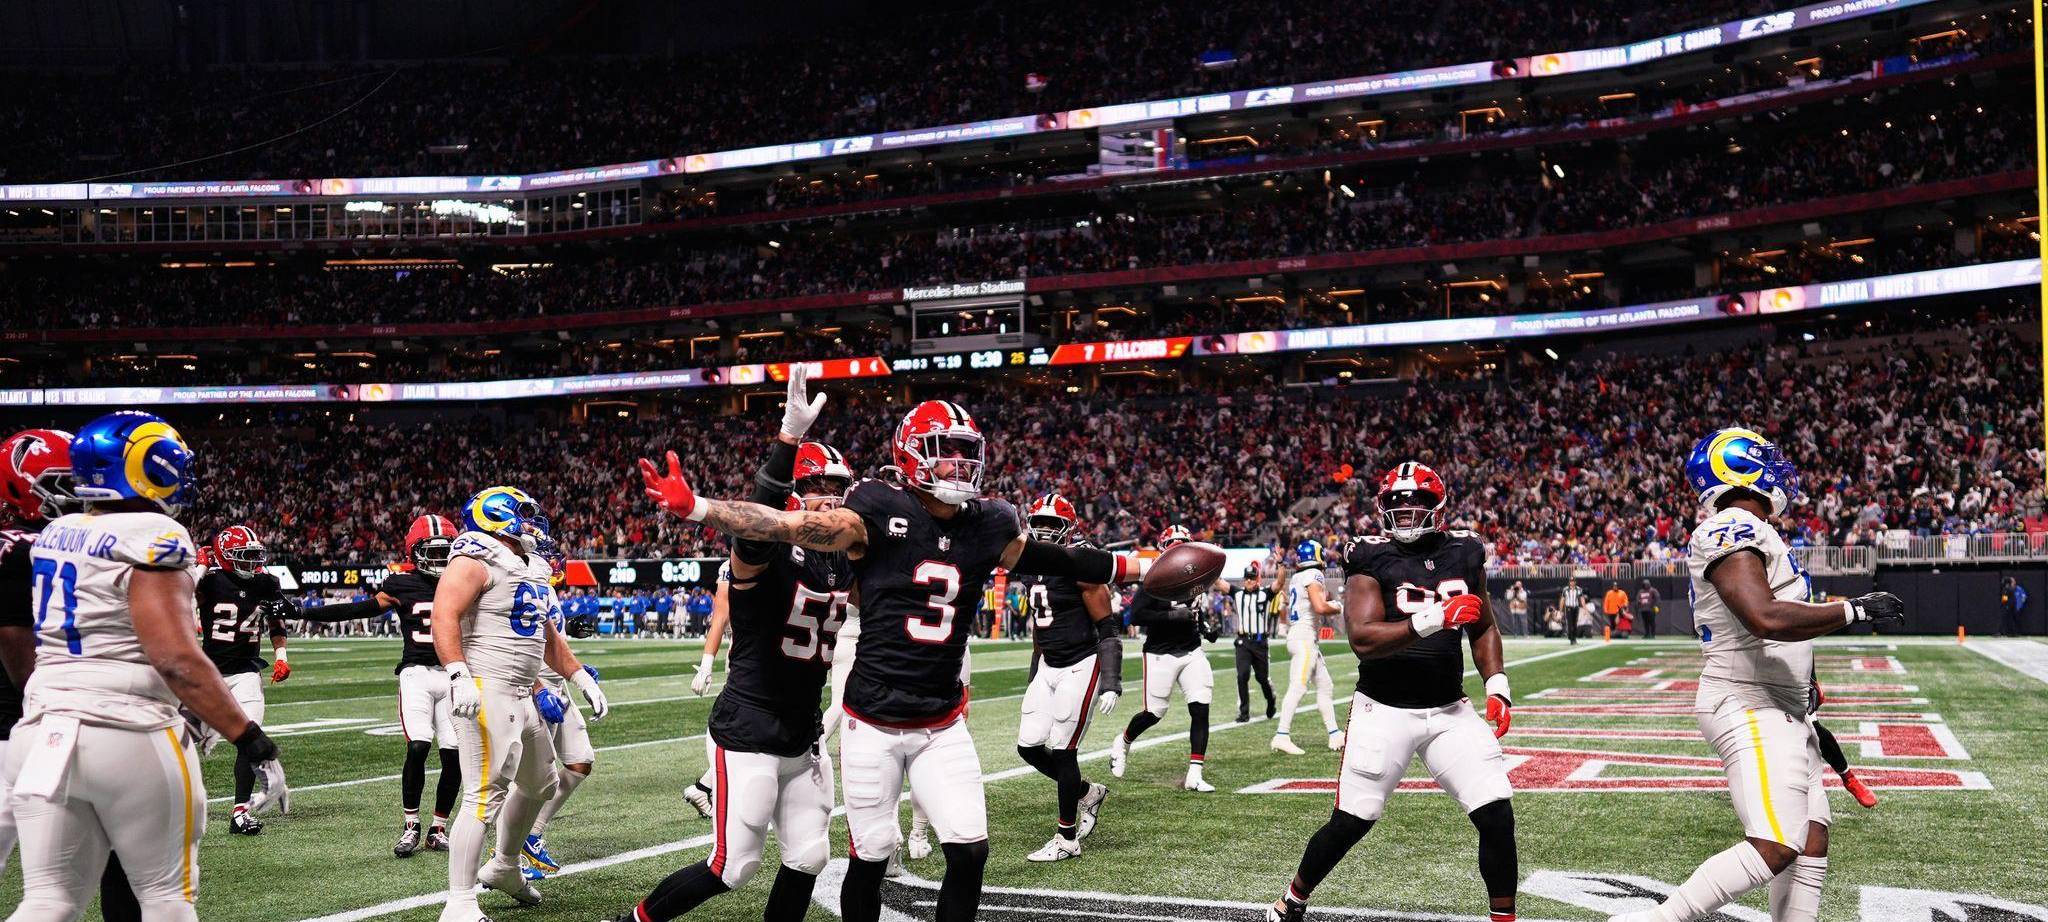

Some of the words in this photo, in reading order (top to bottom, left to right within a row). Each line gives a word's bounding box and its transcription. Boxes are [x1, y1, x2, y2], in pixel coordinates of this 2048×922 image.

[1810, 5, 1843, 20] PROUD
[1305, 86, 1333, 96] PROUD
[1334, 82, 1370, 93] PARTNER
[1370, 80, 1383, 89] OF
[1383, 78, 1400, 88] THE
[1401, 74, 1437, 85] ATLANTA
[1437, 69, 1476, 80] FALCONS
[144, 186, 166, 194] PROUD
[196, 185, 206, 193] OF
[220, 184, 249, 192] ATLANTA
[249, 184, 280, 192] FALCONS
[903, 284, 979, 300] Mercedes-Benz
[980, 280, 1025, 294] Stadium
[1820, 281, 1869, 304] ATLANTA
[1511, 320, 1543, 331] PROUD
[1544, 317, 1584, 329] PARTNER
[1585, 315, 1600, 327] OF
[1600, 313, 1617, 325] THE
[1618, 309, 1657, 322] ATLANTA
[1657, 305, 1699, 318] FALCONS
[1288, 331, 1328, 349] ATLANTA
[1011, 352, 1024, 364] 25
[1084, 345, 1095, 361] 7
[1105, 340, 1167, 360] FALCONS
[850, 360, 860, 376] 0
[920, 358, 928, 369] 3
[971, 351, 1002, 368] 8:30
[197, 391, 228, 399] PARTNER
[254, 390, 284, 398] ATLANTA
[285, 390, 316, 398] FALCONS
[889, 517, 908, 533] C
[1708, 523, 1756, 547] 72
[88, 532, 118, 560] JR
[301, 571, 321, 583] 3RD
[322, 570, 331, 583] &
[331, 571, 338, 583] 3
[344, 570, 358, 584] 25
[610, 568, 637, 583] 2ND
[662, 562, 701, 582] 8:30
[32, 556, 83, 656] 71
[905, 559, 961, 644] 3
[211, 602, 264, 643] 24
